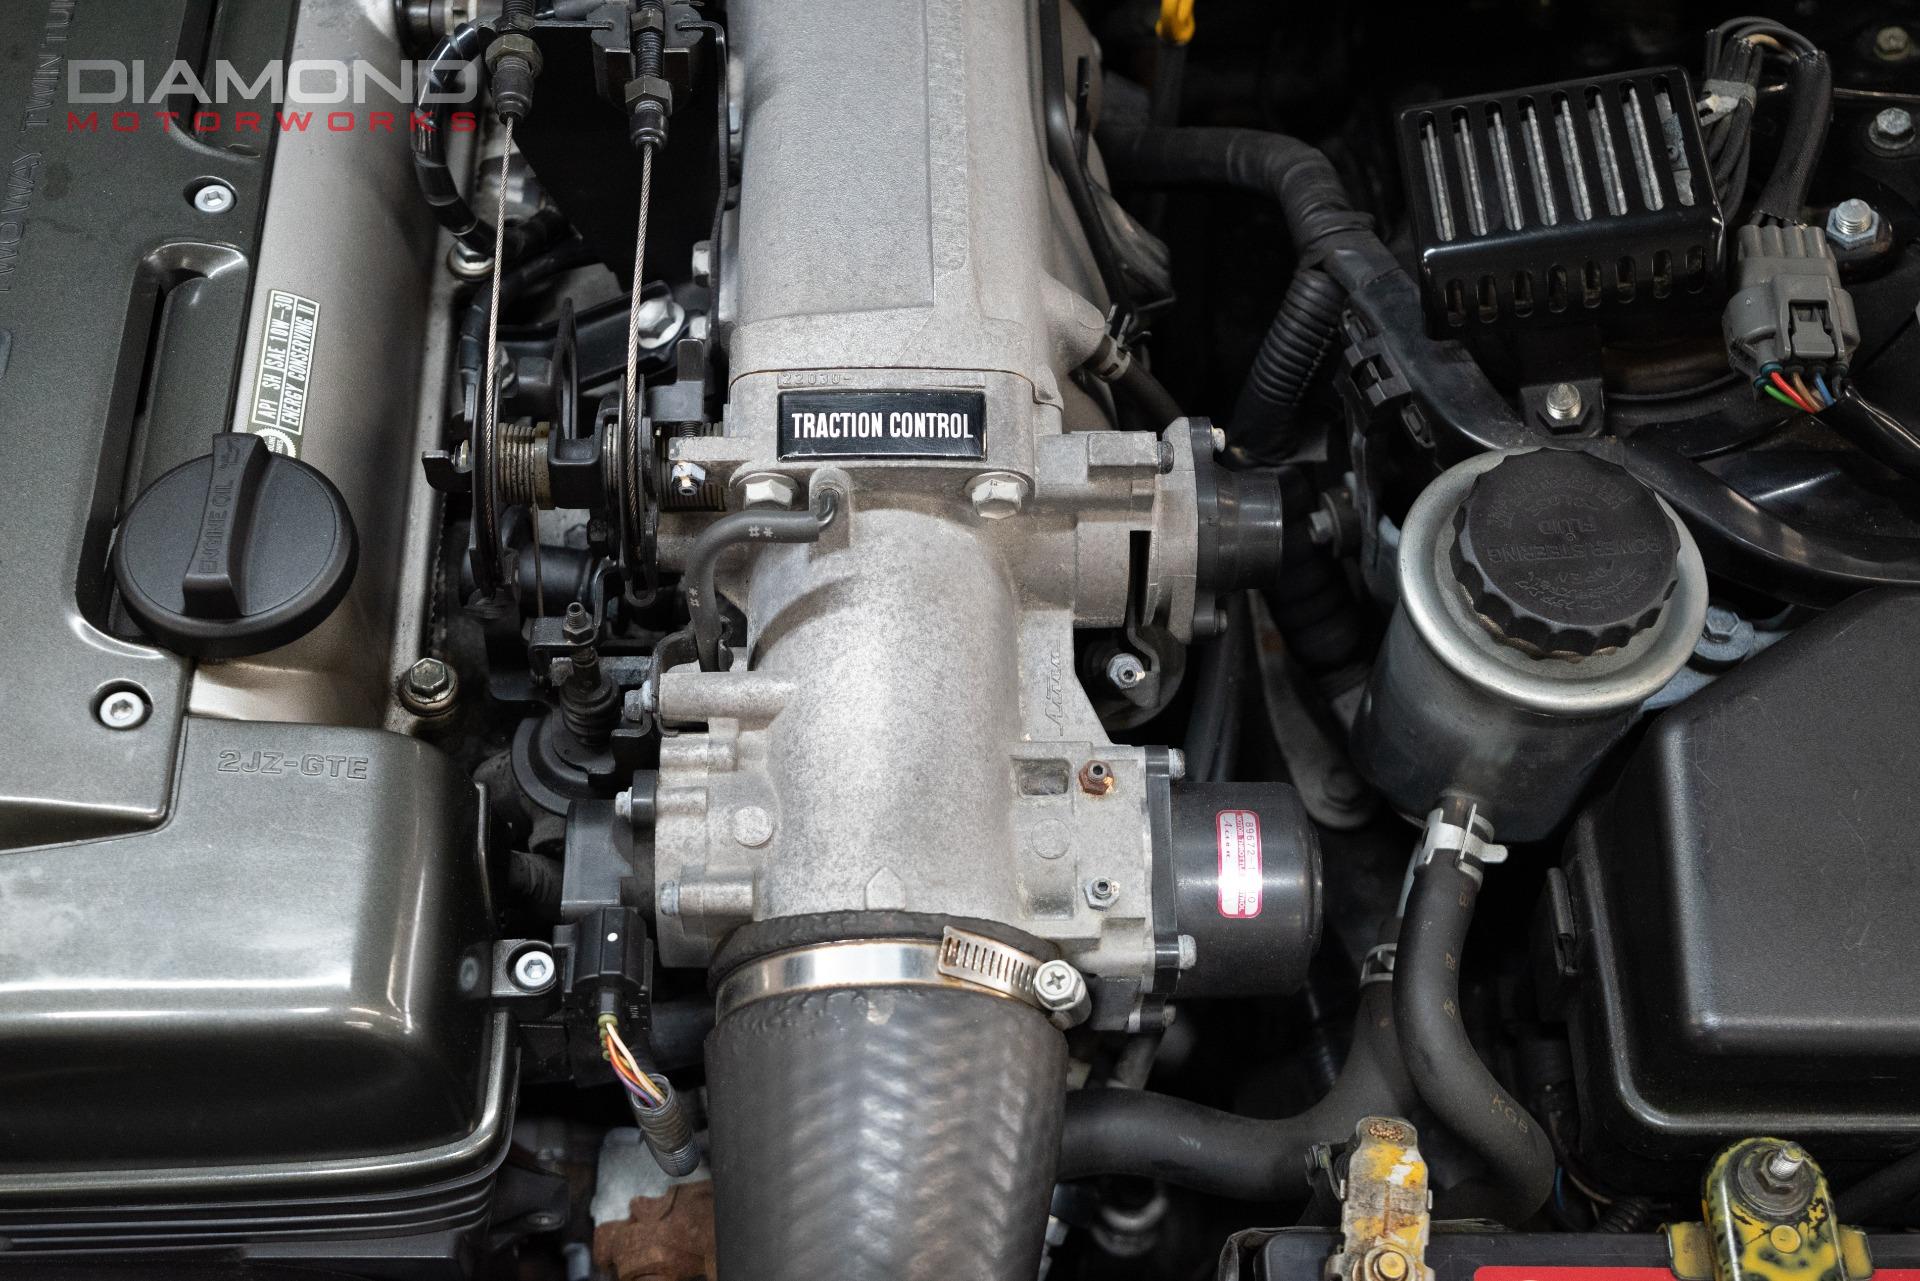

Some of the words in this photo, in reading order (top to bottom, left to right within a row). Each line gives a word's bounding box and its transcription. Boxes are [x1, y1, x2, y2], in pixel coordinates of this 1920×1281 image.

[19, 53, 64, 133] TWIN
[265, 345, 286, 368] SAE
[287, 316, 313, 382] CONSERVING
[262, 373, 282, 390] SH
[257, 399, 279, 420] API
[281, 383, 304, 426] ENERGY
[791, 412, 883, 439] TRACTION
[889, 412, 974, 439] CONTROL
[212, 480, 234, 508] OIL
[198, 510, 228, 573] ENGINE
[1487, 543, 1586, 564] STEERING
[217, 750, 369, 780] 2JZ-GTE
